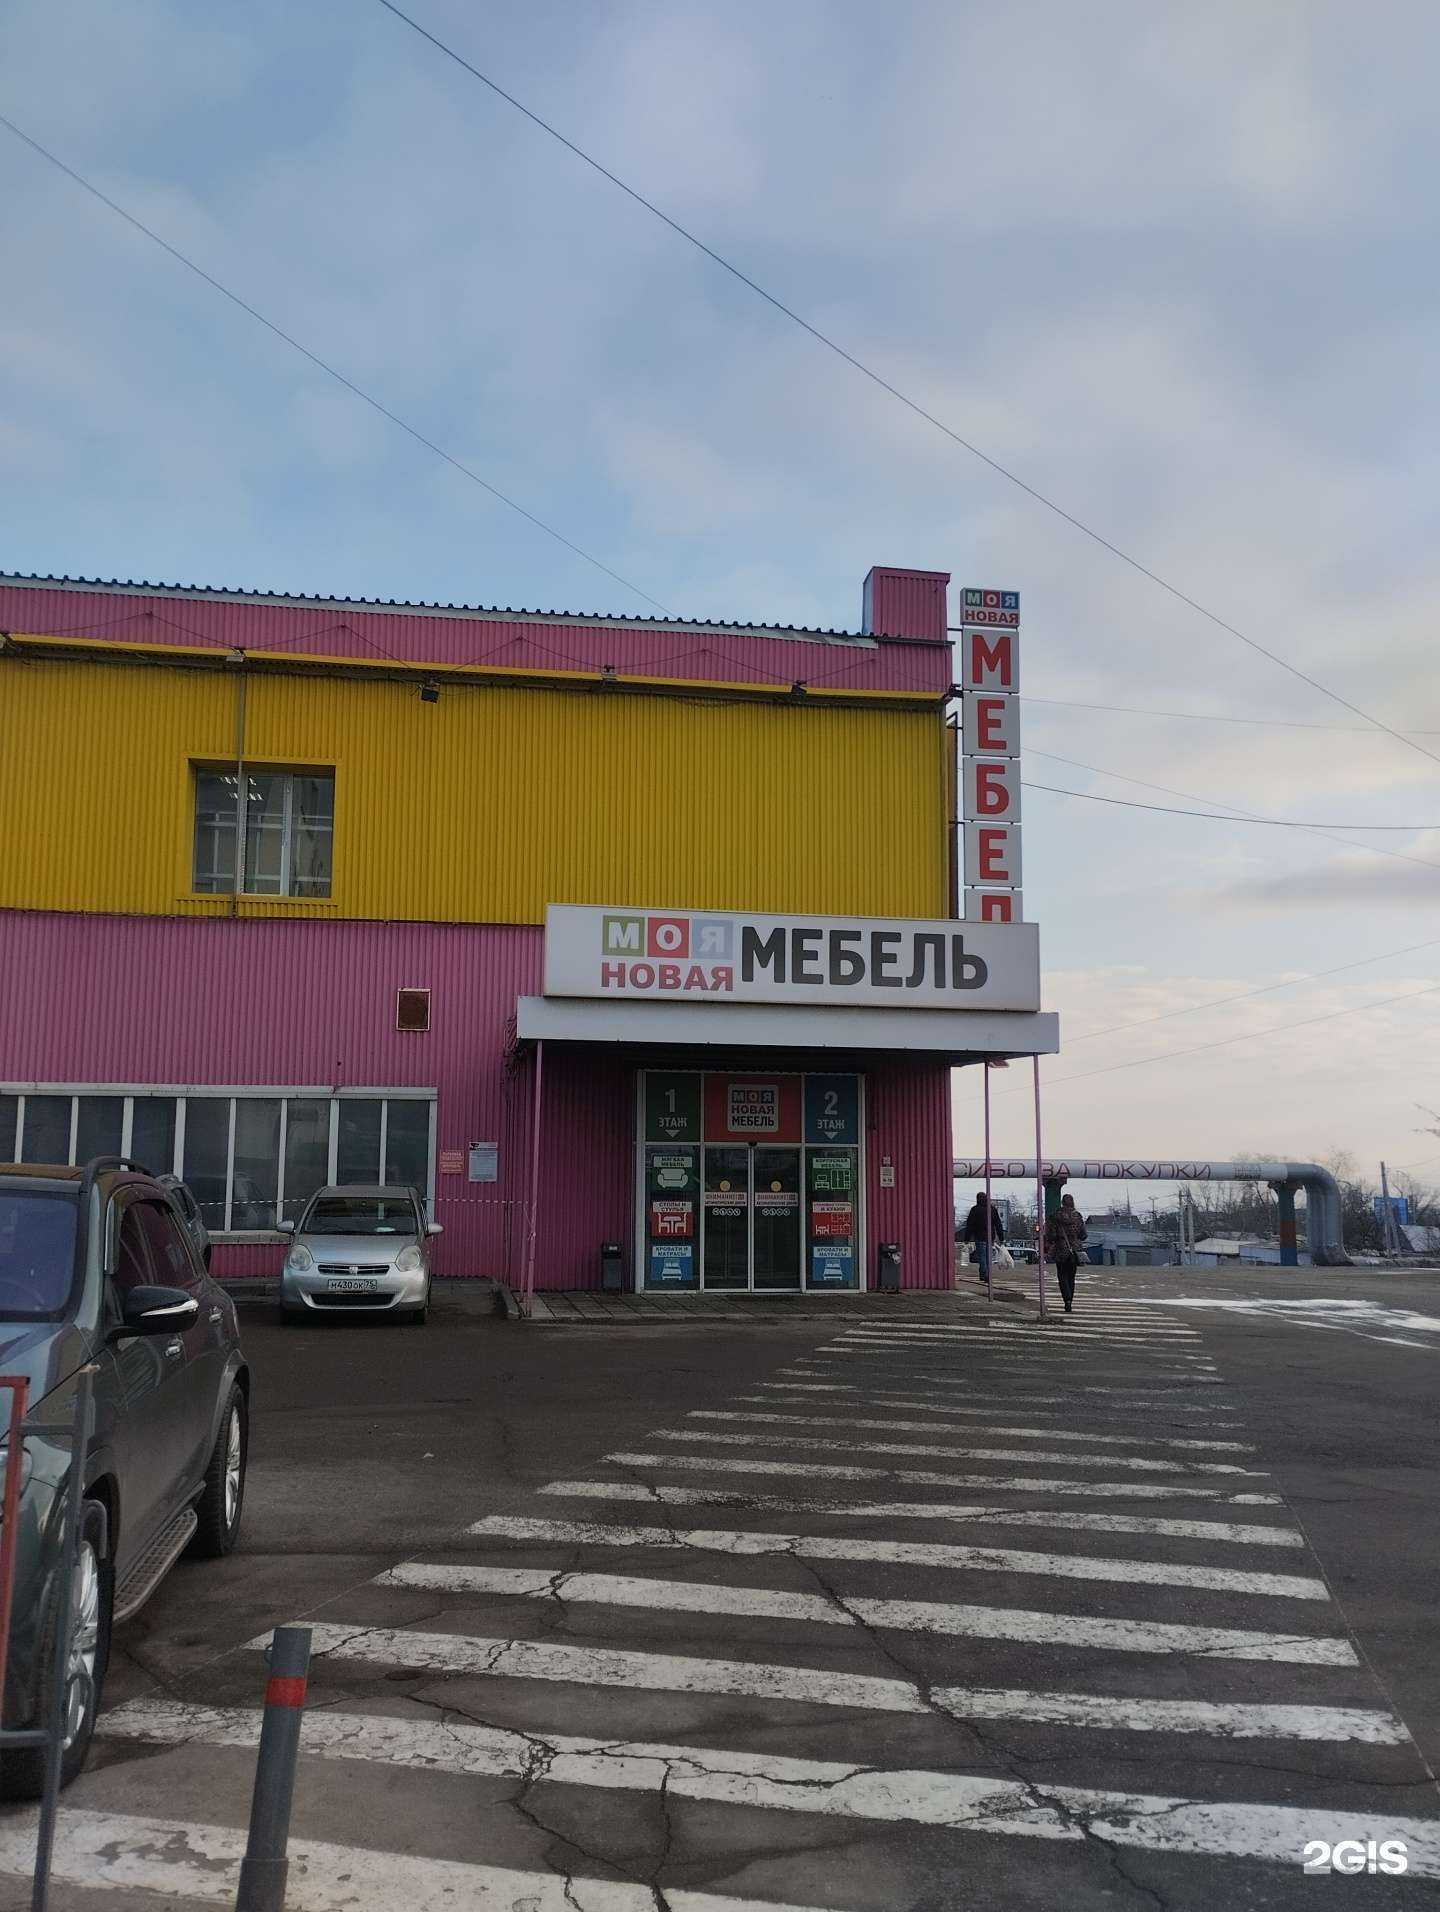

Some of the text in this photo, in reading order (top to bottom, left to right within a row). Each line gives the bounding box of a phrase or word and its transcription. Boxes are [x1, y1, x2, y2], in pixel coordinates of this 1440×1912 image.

[966, 591, 1017, 607] МОЯ
[964, 610, 1019, 624] НОВАЯ
[606, 920, 727, 954] МОЯ
[741, 926, 989, 990] МЕБЕЛЬ
[600, 962, 734, 992] НОВАЯ
[664, 1088, 677, 1113] 1
[733, 1091, 773, 1102] МОЯ
[823, 1091, 838, 1115] 2
[731, 1104, 775, 1115] НОВАЯ
[658, 1117, 688, 1128] ЭТАЖ
[731, 1115, 775, 1127] МЕБЕЛЬ
[816, 1119, 845, 1130] ЭТАЖ
[1040, 1162, 1071, 1178] ЗА
[1083, 1163, 1211, 1179] ПОКУПКИ
